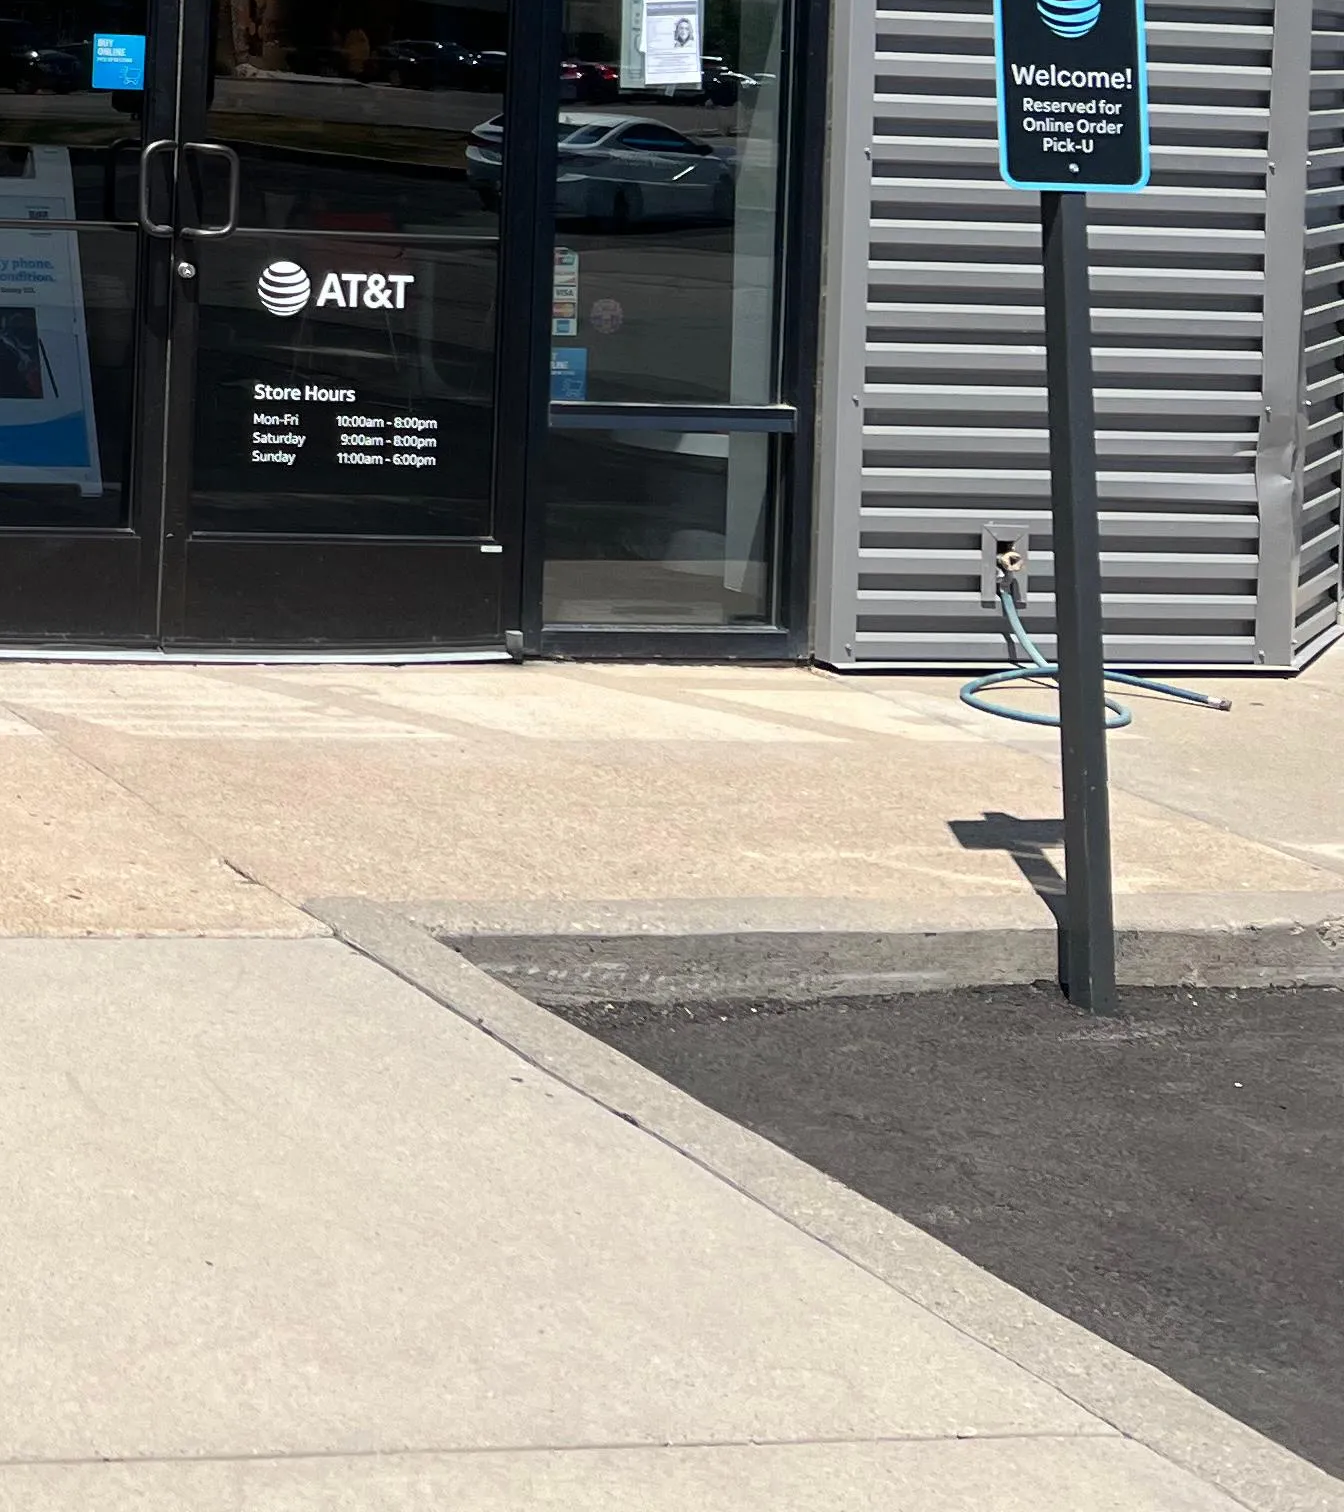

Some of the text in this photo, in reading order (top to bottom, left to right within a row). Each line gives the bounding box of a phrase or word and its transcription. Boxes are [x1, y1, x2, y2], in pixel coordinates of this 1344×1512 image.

[1010, 63, 1133, 90] Welcome!
[1023, 97, 1122, 115] Reserved for
[1022, 117, 1124, 135] Online Order
[1042, 137, 1094, 154] Pick-U
[12, 257, 55, 271] phone.
[316, 272, 415, 309] AT&T
[556, 288, 574, 296] VISA
[253, 383, 356, 403] Store Hours
[253, 413, 300, 426] Mon-Fri
[336, 415, 385, 428] 10:00am
[393, 417, 438, 431] 8:00pm
[252, 432, 306, 447] Saturday
[340, 434, 383, 447] 9:00am
[393, 435, 437, 449] 8:00pm
[252, 450, 296, 465] Sunday
[337, 452, 383, 465] 11:00am
[392, 453, 437, 468] 6:00pm
